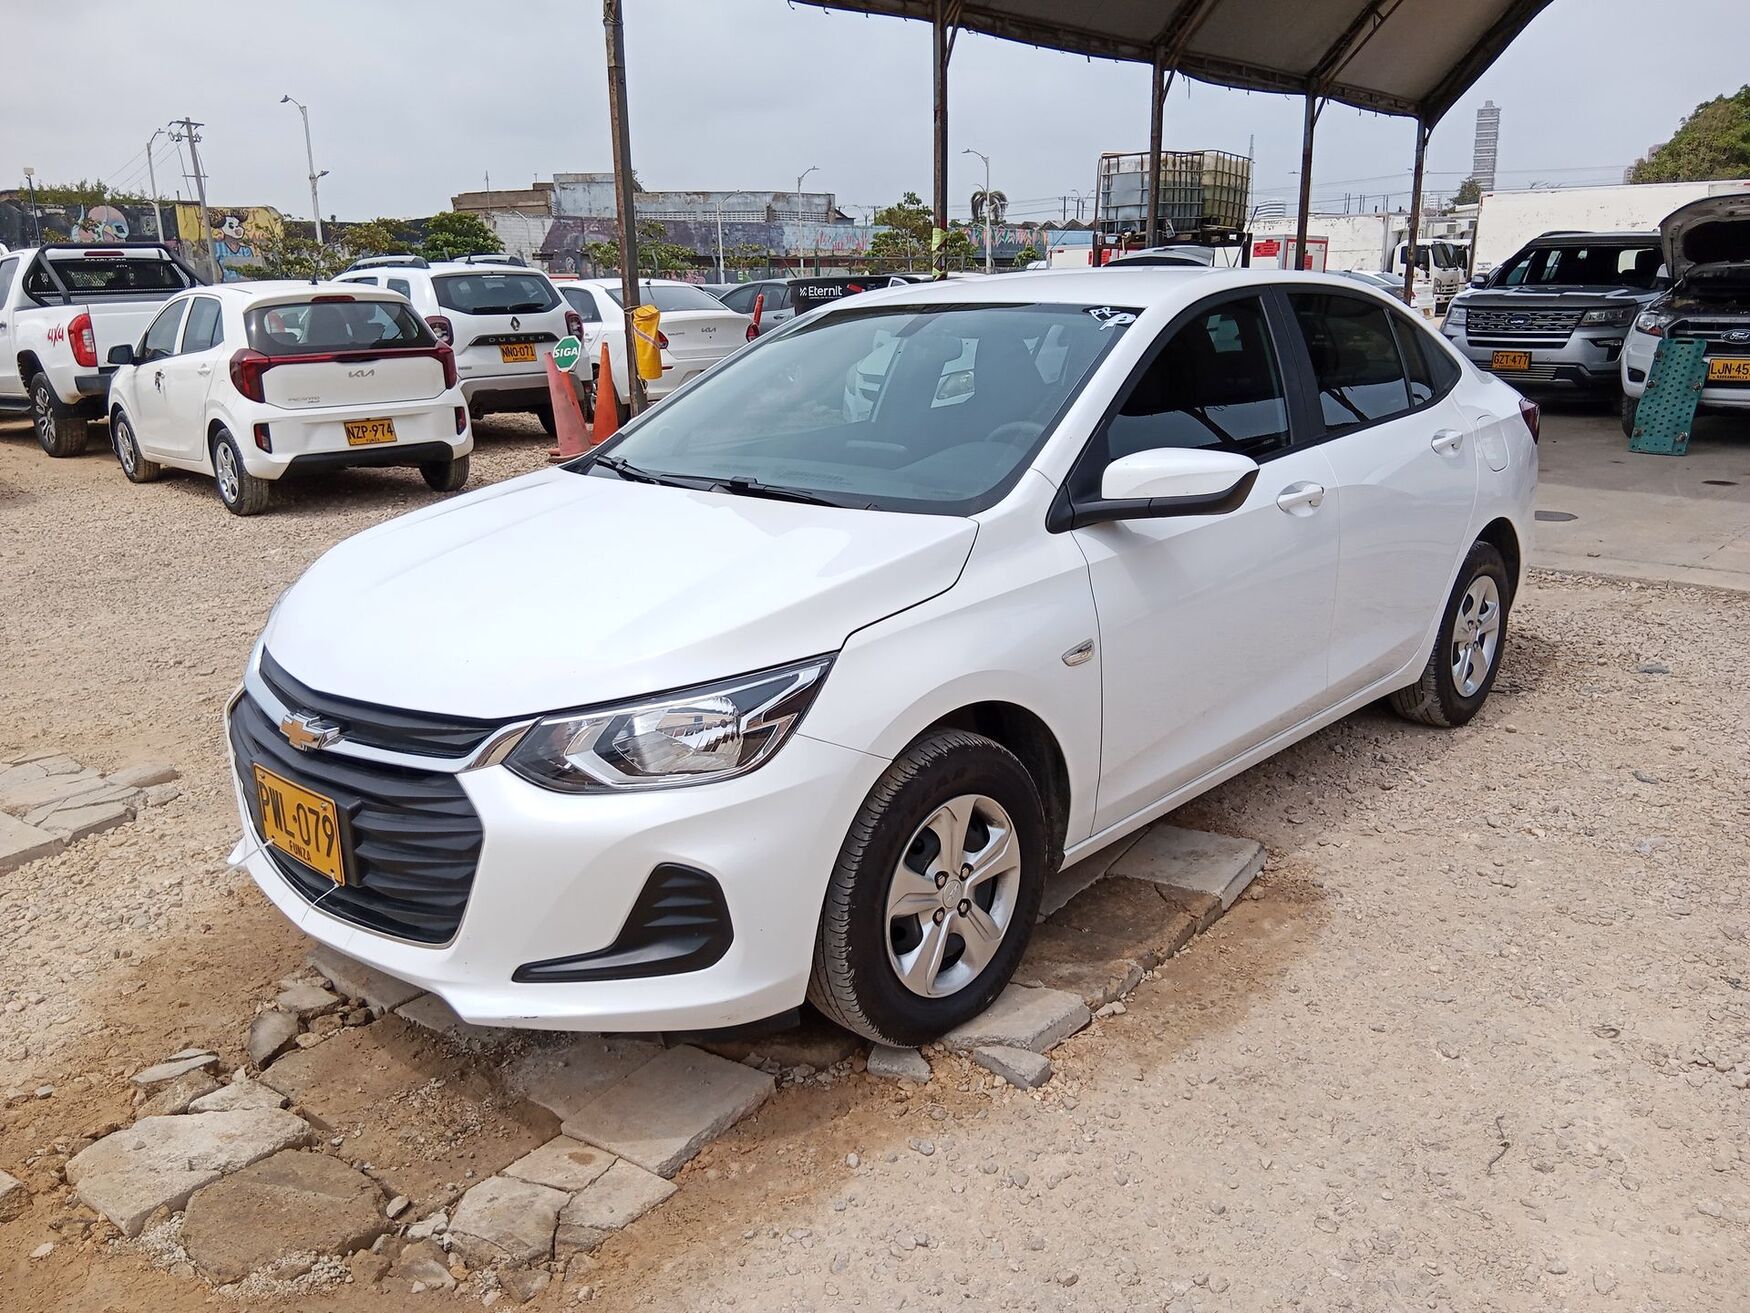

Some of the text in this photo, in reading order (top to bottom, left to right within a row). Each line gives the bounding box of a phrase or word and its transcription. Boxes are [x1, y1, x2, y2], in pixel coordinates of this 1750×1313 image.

[808, 285, 842, 297] Eternit
[488, 335, 545, 343] DUSTER
[554, 346, 578, 358] SIGA
[348, 369, 375, 378] KIA
[1710, 362, 1750, 376] LJN·45
[289, 840, 313, 863] FUNZA
